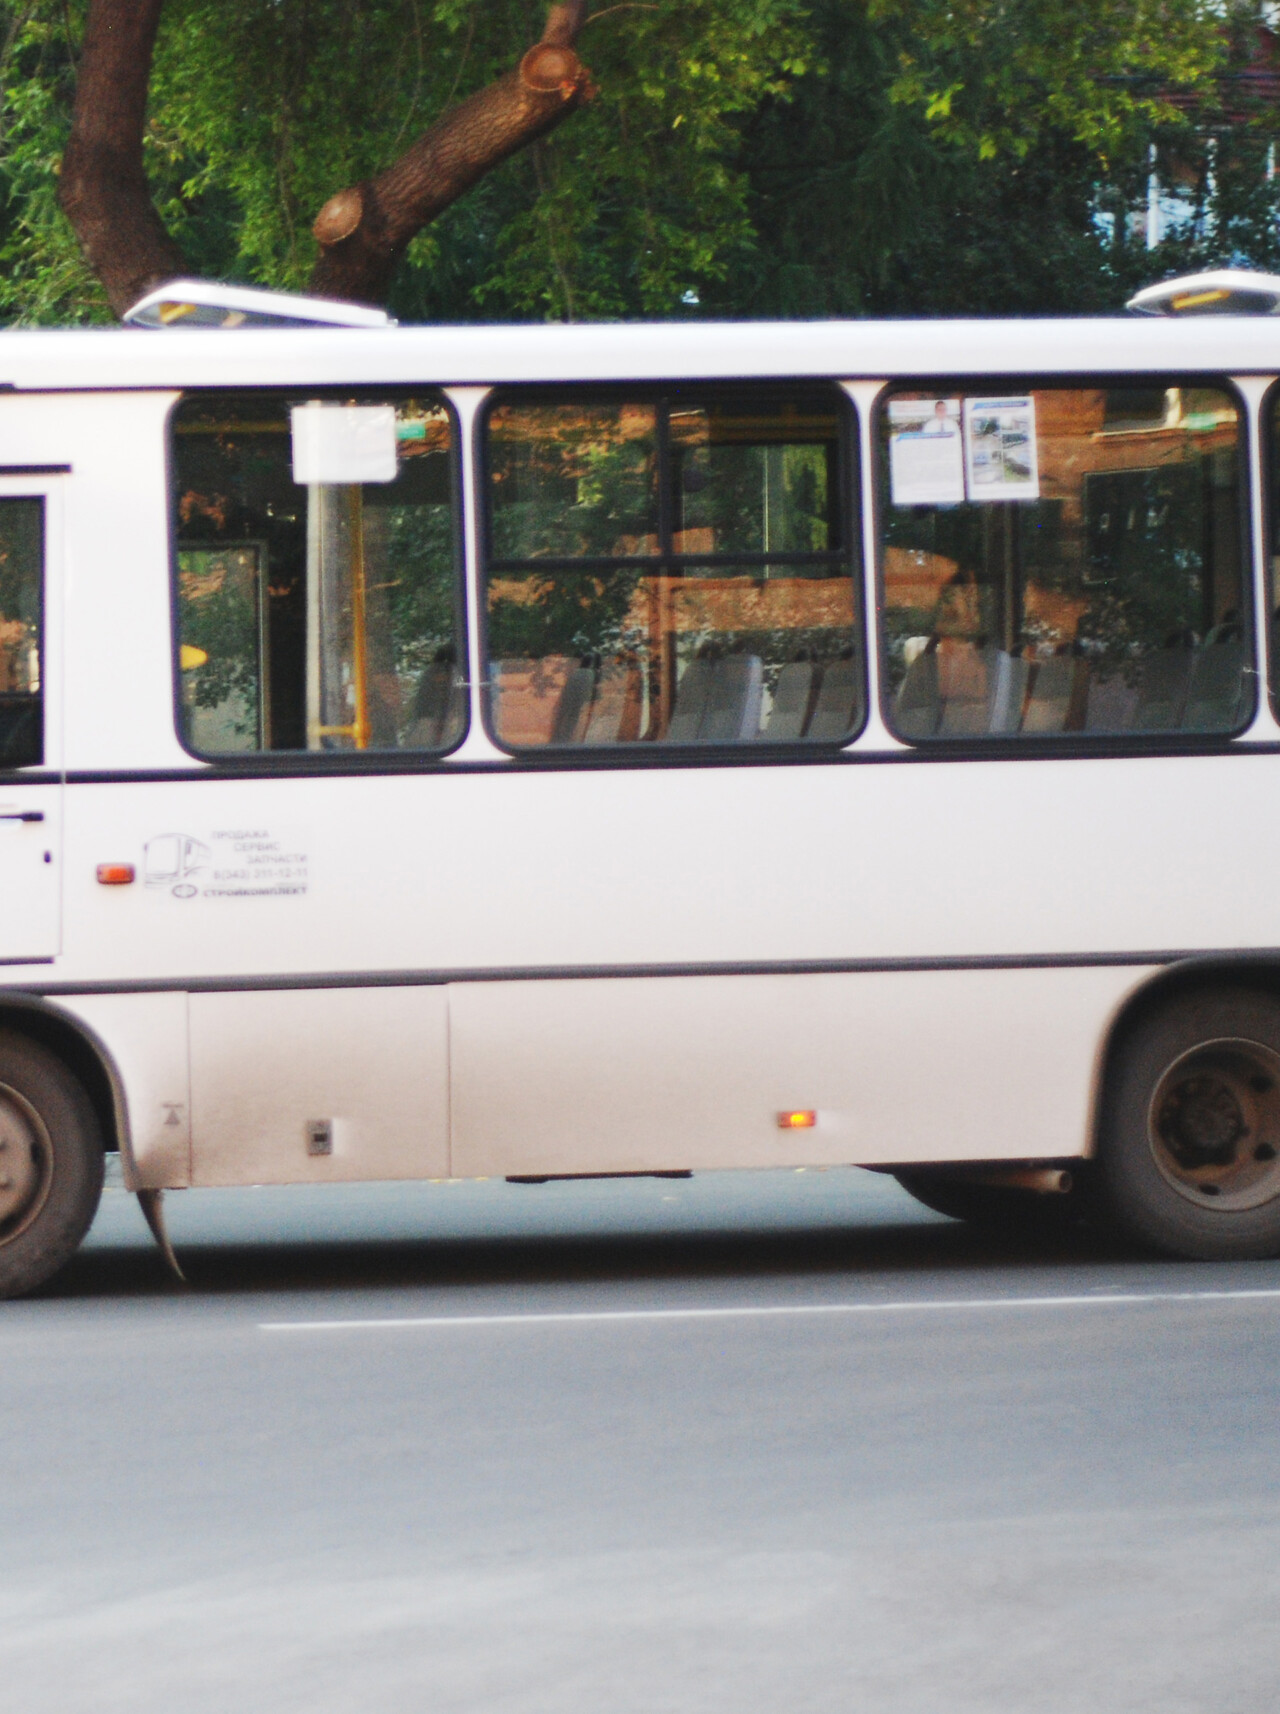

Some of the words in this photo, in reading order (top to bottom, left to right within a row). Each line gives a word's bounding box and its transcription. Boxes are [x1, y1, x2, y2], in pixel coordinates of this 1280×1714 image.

[212, 830, 269, 840] ПРОДАЖА
[233, 842, 280, 852] СЕРВИС
[247, 853, 308, 864] ЗАПЧАСТИ
[203, 886, 308, 897] СТРОЙКОМПЛЕКТ
